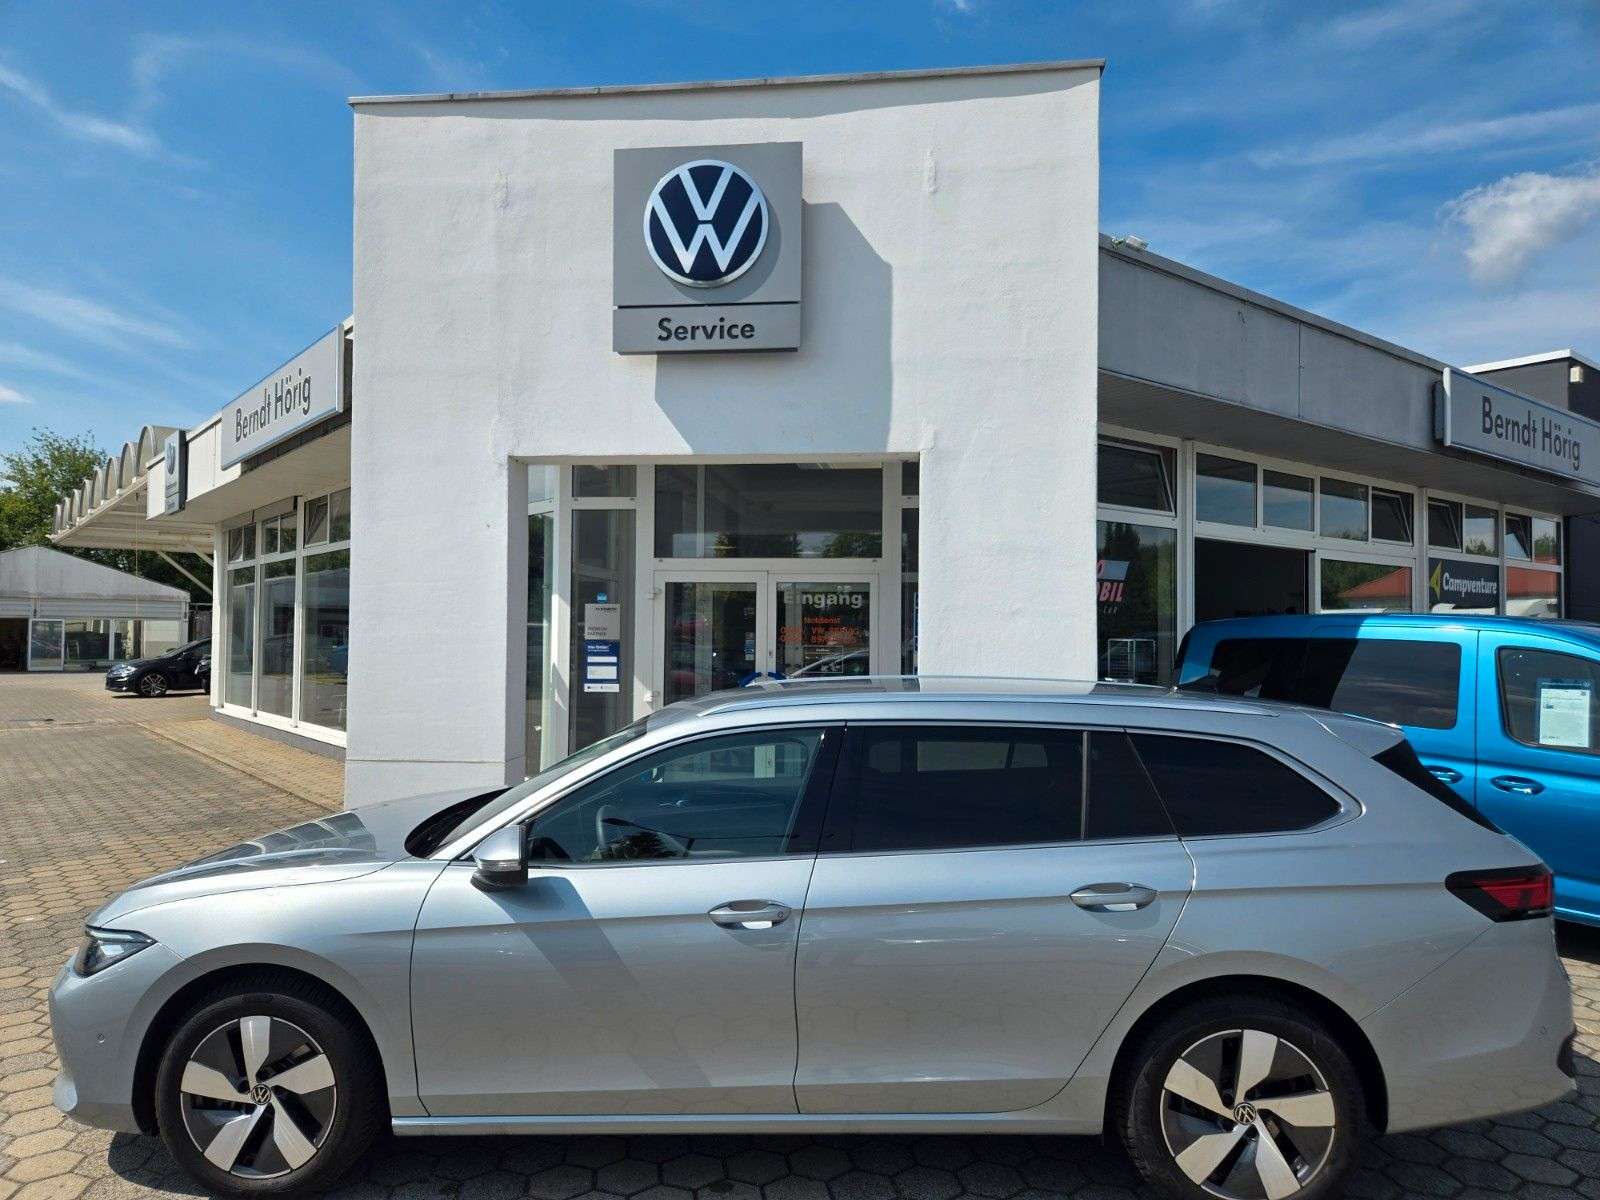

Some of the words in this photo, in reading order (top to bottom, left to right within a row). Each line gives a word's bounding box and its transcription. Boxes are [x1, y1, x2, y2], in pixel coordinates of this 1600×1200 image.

[650, 164, 763, 277] VW
[657, 316, 755, 342] Service
[235, 388, 271, 442] Berndt
[274, 368, 312, 420] Hörig
[1482, 396, 1537, 448] Berndt
[1542, 417, 1582, 471] Hörig
[784, 591, 863, 609] Eingang
[1443, 572, 1498, 597] Campventure
